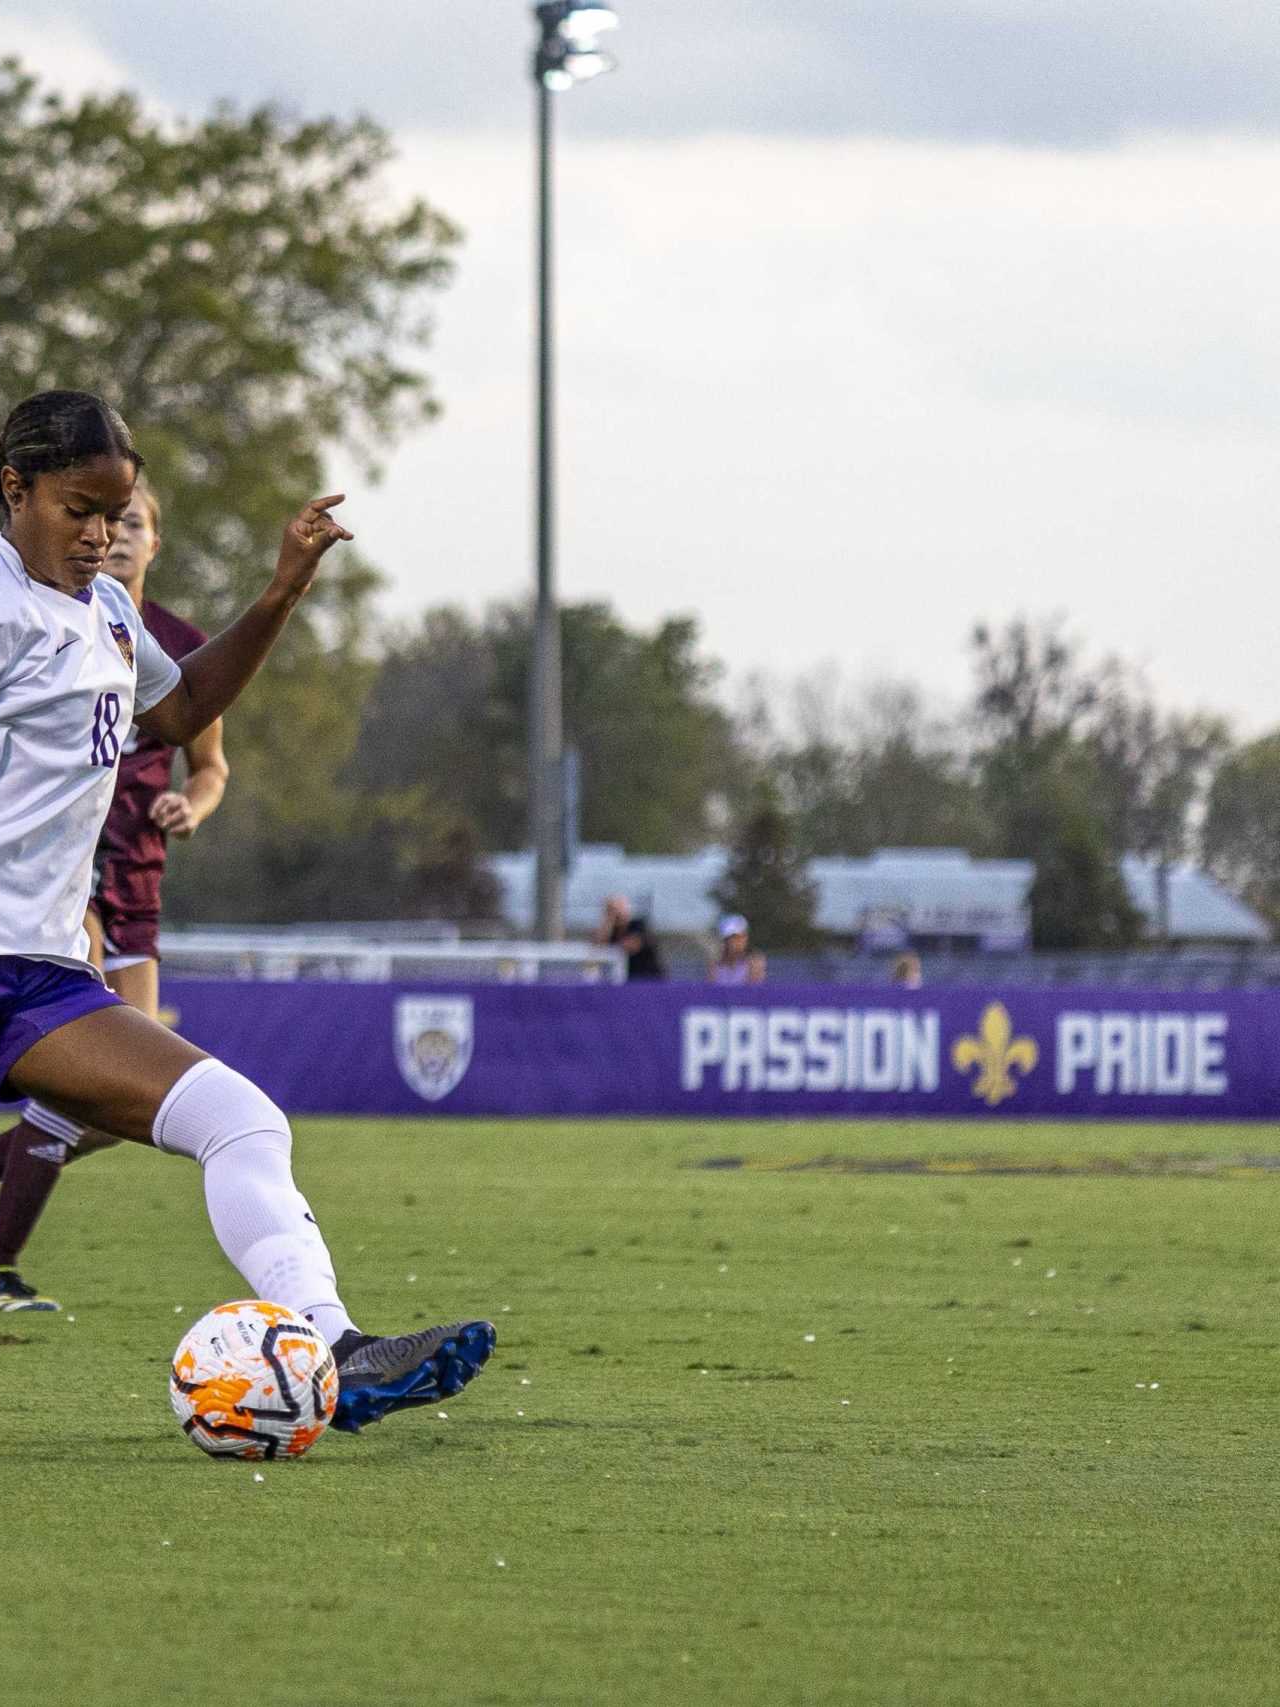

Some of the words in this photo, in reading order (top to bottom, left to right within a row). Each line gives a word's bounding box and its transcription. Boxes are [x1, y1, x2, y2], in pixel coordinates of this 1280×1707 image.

[91, 692, 120, 768] 18
[681, 1008, 940, 1092] PASSION
[1056, 1012, 1228, 1095] PRIDE
